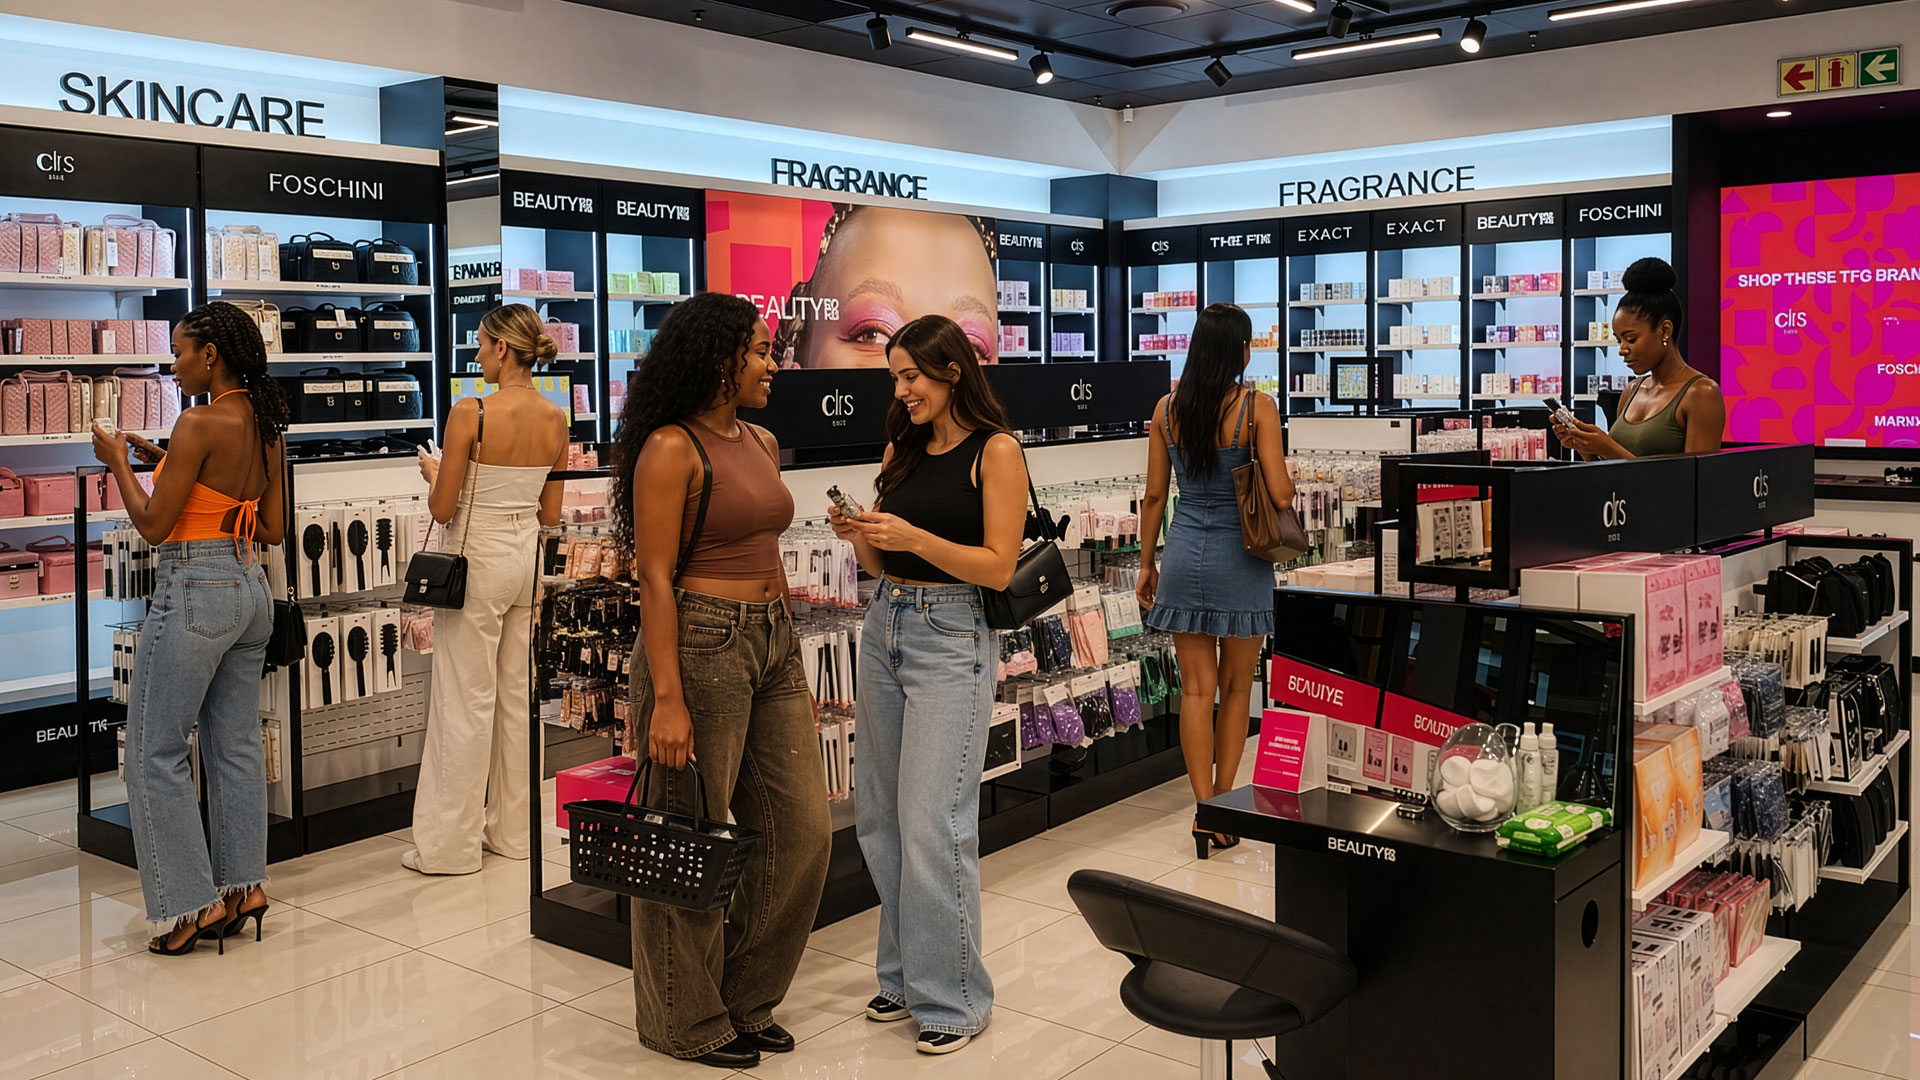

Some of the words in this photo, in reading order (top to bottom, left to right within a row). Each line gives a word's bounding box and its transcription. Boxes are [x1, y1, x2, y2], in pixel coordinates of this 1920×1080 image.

[58, 72, 326, 139] SKINCARE
[269, 173, 384, 200] FOSCHINI
[771, 158, 928, 200] FRAGRANCE
[1279, 165, 1475, 207] FRAGRANCE
[1579, 203, 1662, 222] FOSCHINI
[1298, 226, 1353, 242] EXACT
[1386, 219, 1446, 235] EXACT
[1738, 273, 1782, 288] SHOP
[1839, 269, 1872, 284] TFG
